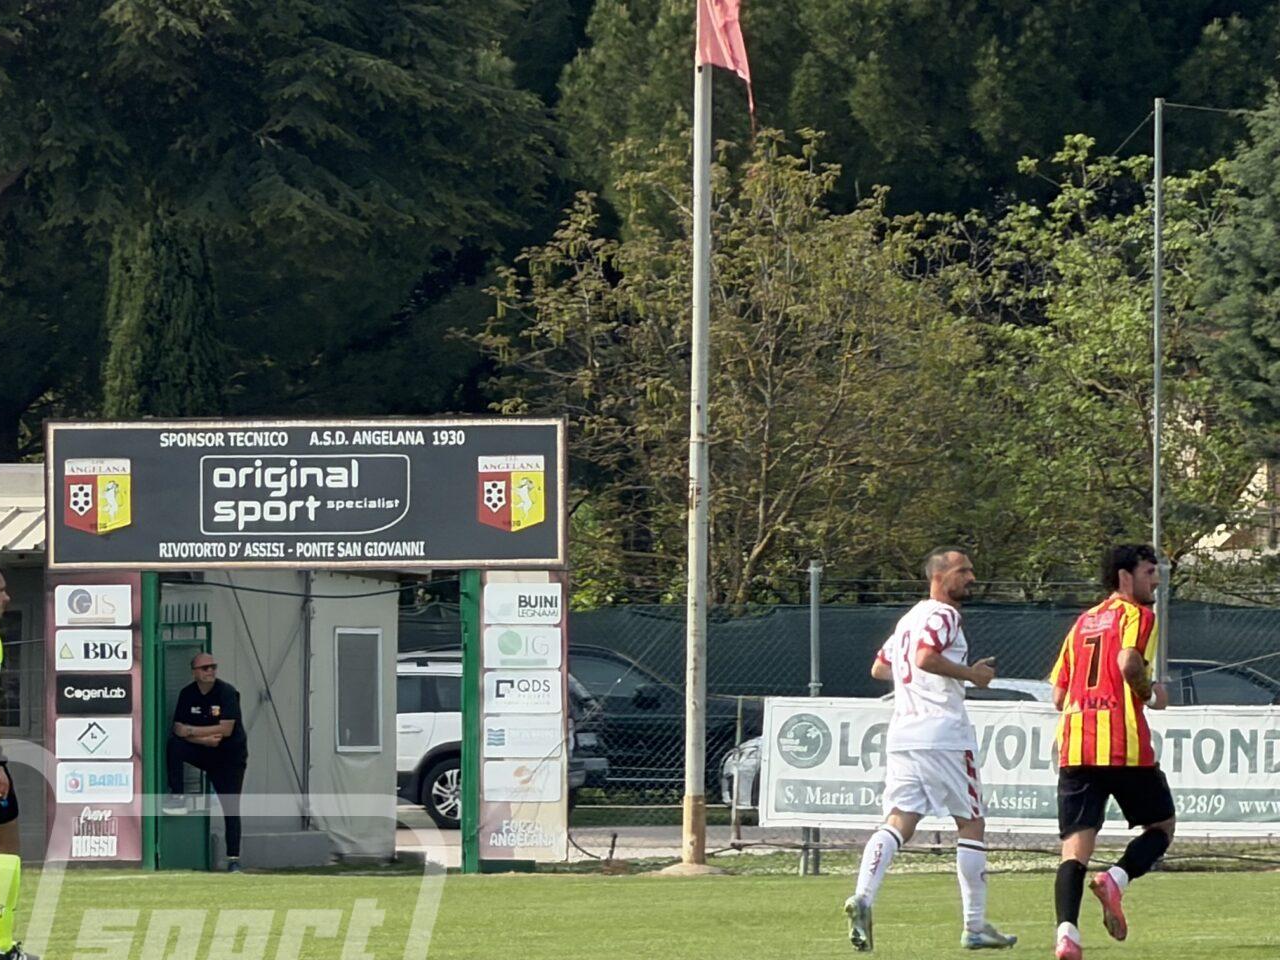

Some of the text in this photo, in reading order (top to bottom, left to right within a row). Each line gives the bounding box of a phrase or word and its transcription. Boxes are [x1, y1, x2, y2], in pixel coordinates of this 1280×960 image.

[160, 431, 288, 448] SPONSOR TECNICO
[309, 430, 465, 446] A.S.D. ANGELANA 1930
[212, 459, 359, 497] original
[212, 495, 321, 531] sport
[326, 498, 400, 511] specialist
[159, 542, 227, 558] RIVOTORTO
[244, 542, 285, 557] ASSISI
[296, 542, 335, 557] PONTE
[337, 542, 362, 557] SAN
[364, 541, 425, 557] GIOVANNI
[518, 595, 558, 608] BUINI
[518, 608, 559, 618] LEGNAMI
[83, 642, 128, 660] BDG
[64, 686, 126, 700] CogenLab
[517, 679, 551, 692] QDS
[784, 785, 799, 804] S.
[805, 786, 854, 806] Maria
[860, 787, 884, 806] De
[987, 790, 1038, 810] Assisi
[72, 835, 118, 857] ROSSO
